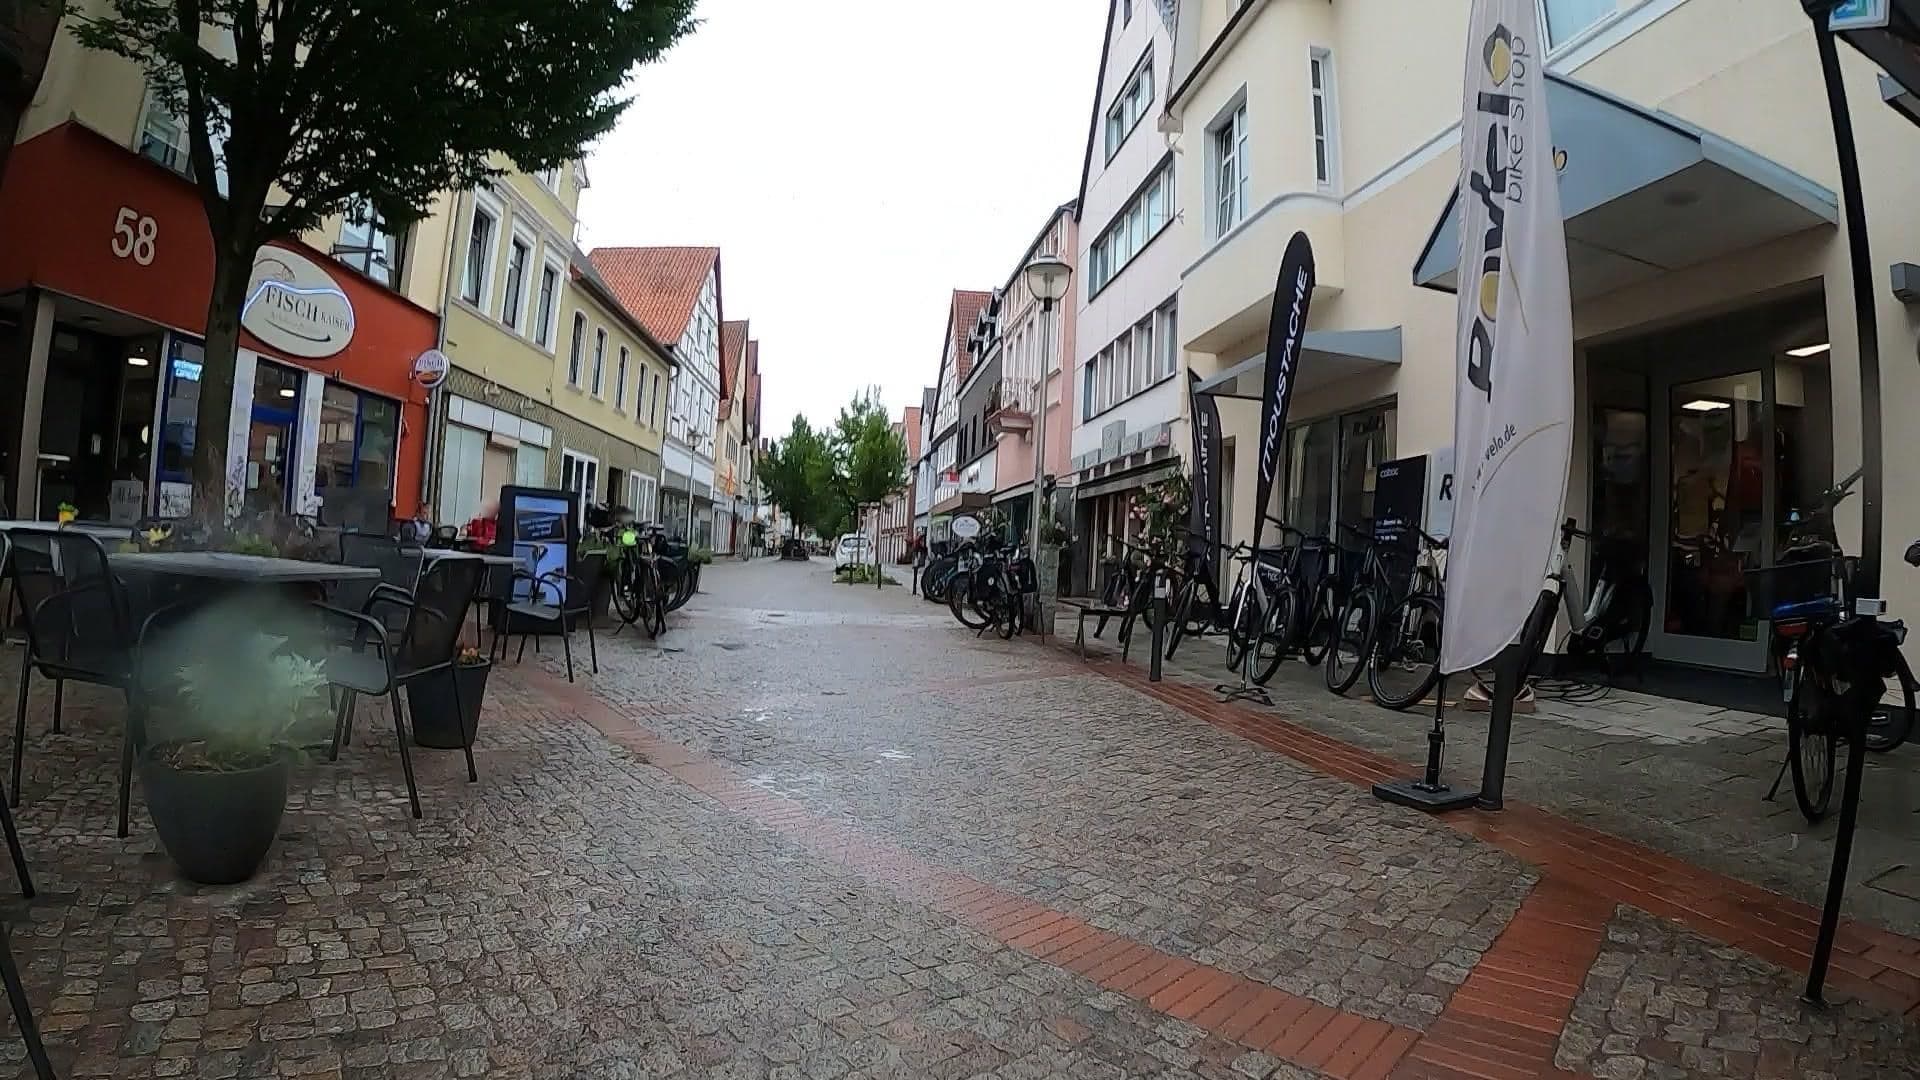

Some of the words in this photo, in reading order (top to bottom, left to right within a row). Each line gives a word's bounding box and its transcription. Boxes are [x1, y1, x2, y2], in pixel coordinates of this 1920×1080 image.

[1509, 36, 1531, 122] shop
[1506, 134, 1523, 204] bike
[111, 207, 158, 266] 58
[265, 286, 318, 322] FISCH
[320, 312, 351, 333] KAISER
[1261, 264, 1308, 483] MOUSTACHE
